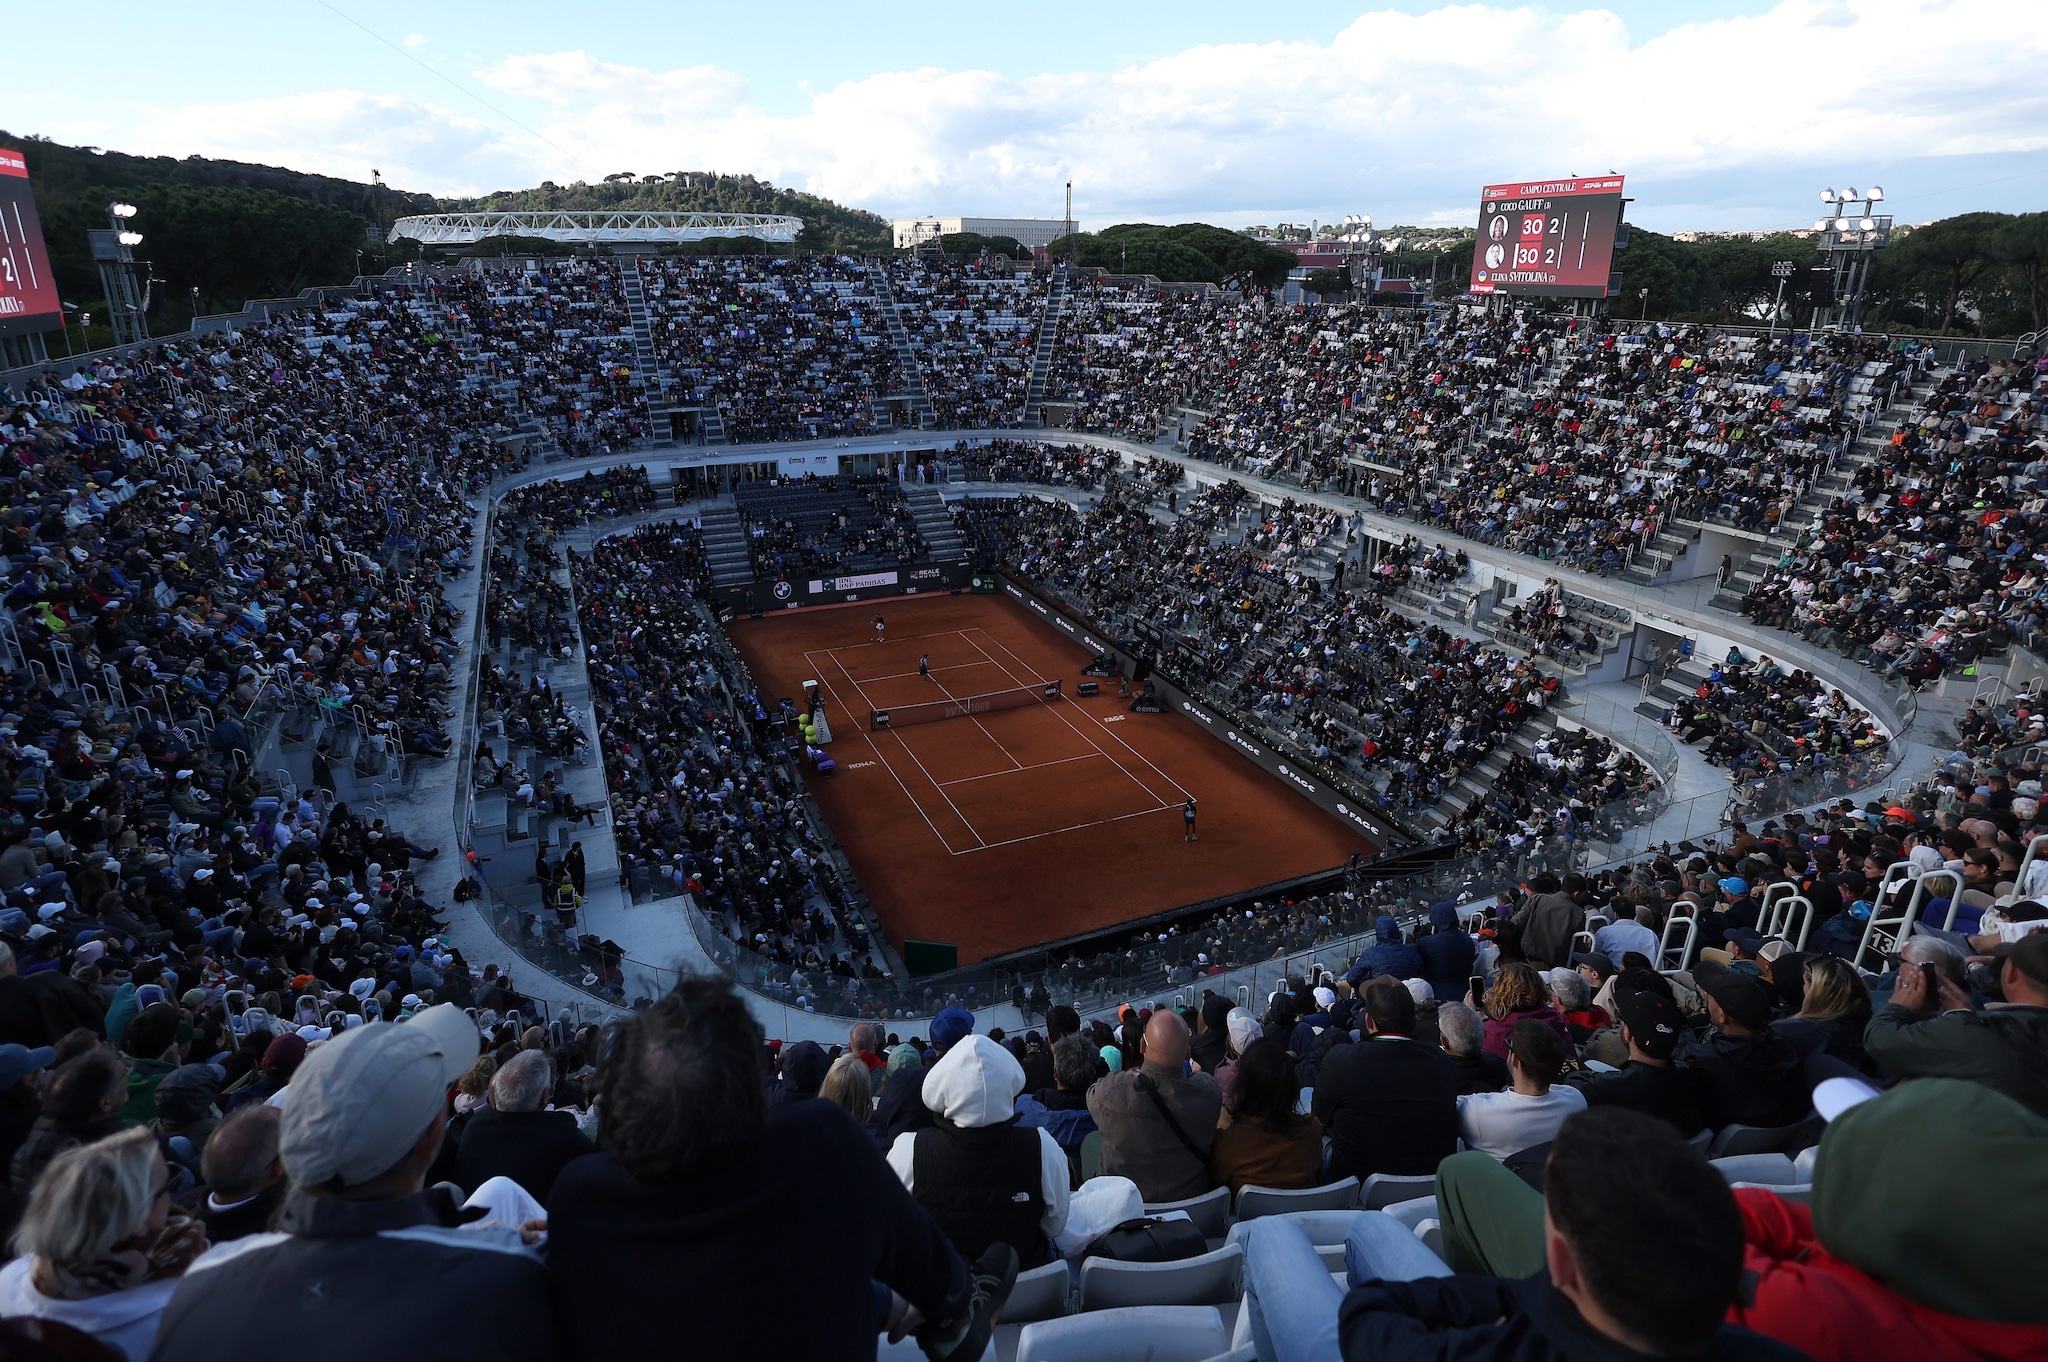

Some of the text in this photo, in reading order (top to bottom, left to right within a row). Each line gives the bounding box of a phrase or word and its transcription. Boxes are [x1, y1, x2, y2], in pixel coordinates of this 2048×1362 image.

[1520, 184, 1542, 195] CAMPO
[1543, 182, 1577, 193] CENTRALE
[1500, 202, 1518, 212] COCO
[1518, 199, 1545, 211] GAUFF
[1522, 218, 1559, 235] 30 2
[1518, 248, 1555, 264] 30 2
[2, 257, 15, 282] 2
[1491, 273, 1508, 282] ELINA
[1509, 271, 1548, 283] SVITOLINA
[918, 568, 941, 576] REALE
[855, 578, 886, 587] PARIBAS
[971, 701, 990, 713] TOUR
[816, 718, 824, 743] RUMMO
[848, 760, 876, 769] ROMA
[1871, 932, 1894, 954] 13
